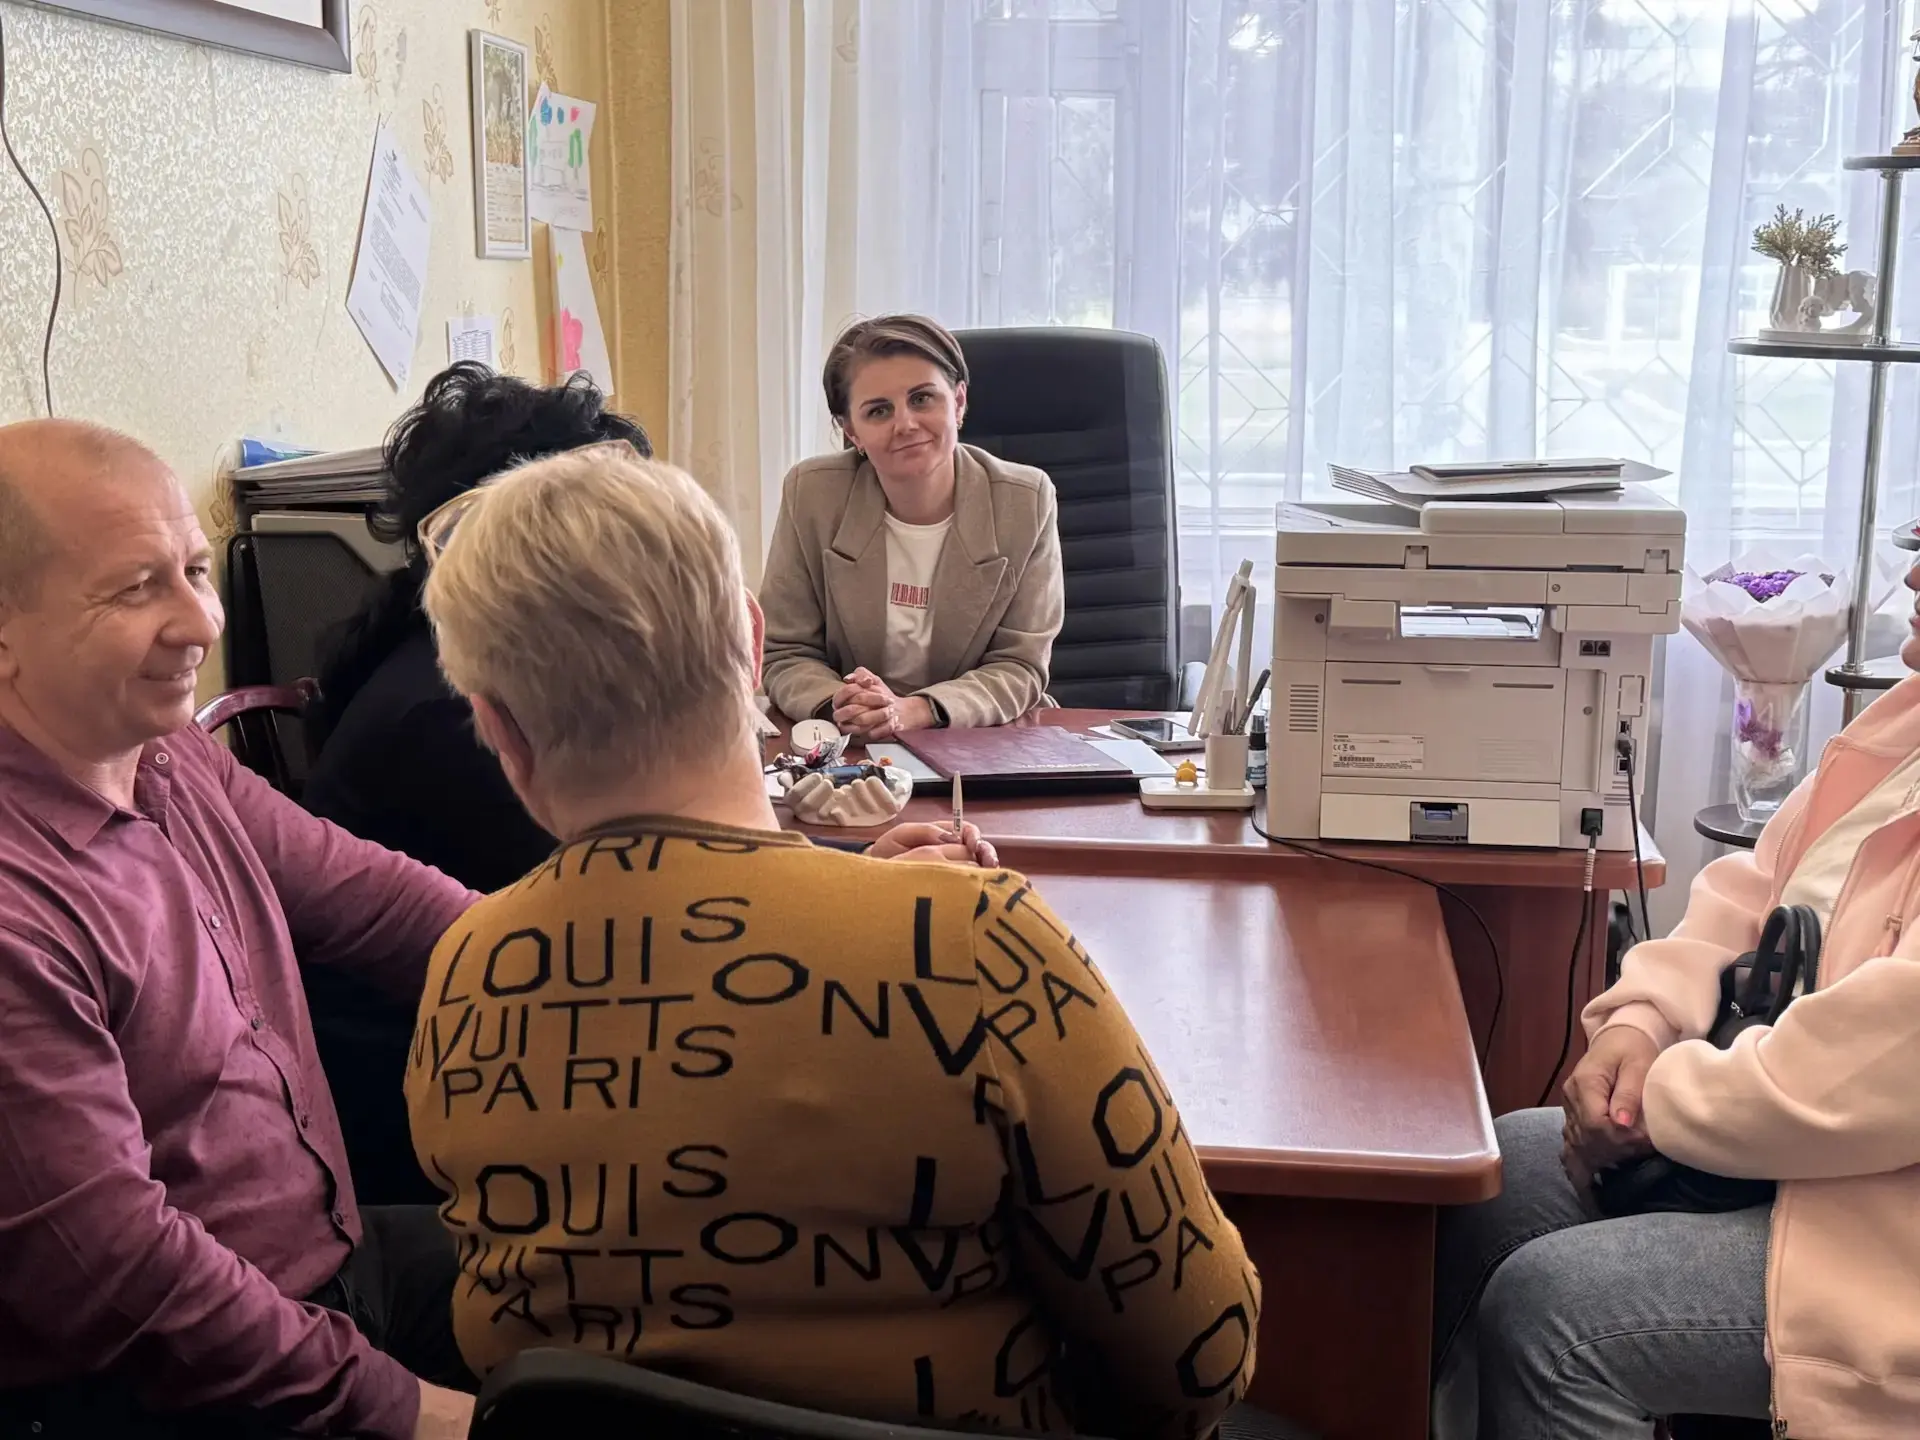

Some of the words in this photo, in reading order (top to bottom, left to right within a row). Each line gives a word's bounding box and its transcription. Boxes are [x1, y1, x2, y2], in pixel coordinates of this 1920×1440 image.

[438, 896, 752, 1008] LOUIS
[441, 1025, 736, 1120] PARIS
[431, 1144, 729, 1237] LOUIS
[466, 1278, 736, 1356] ARIS
